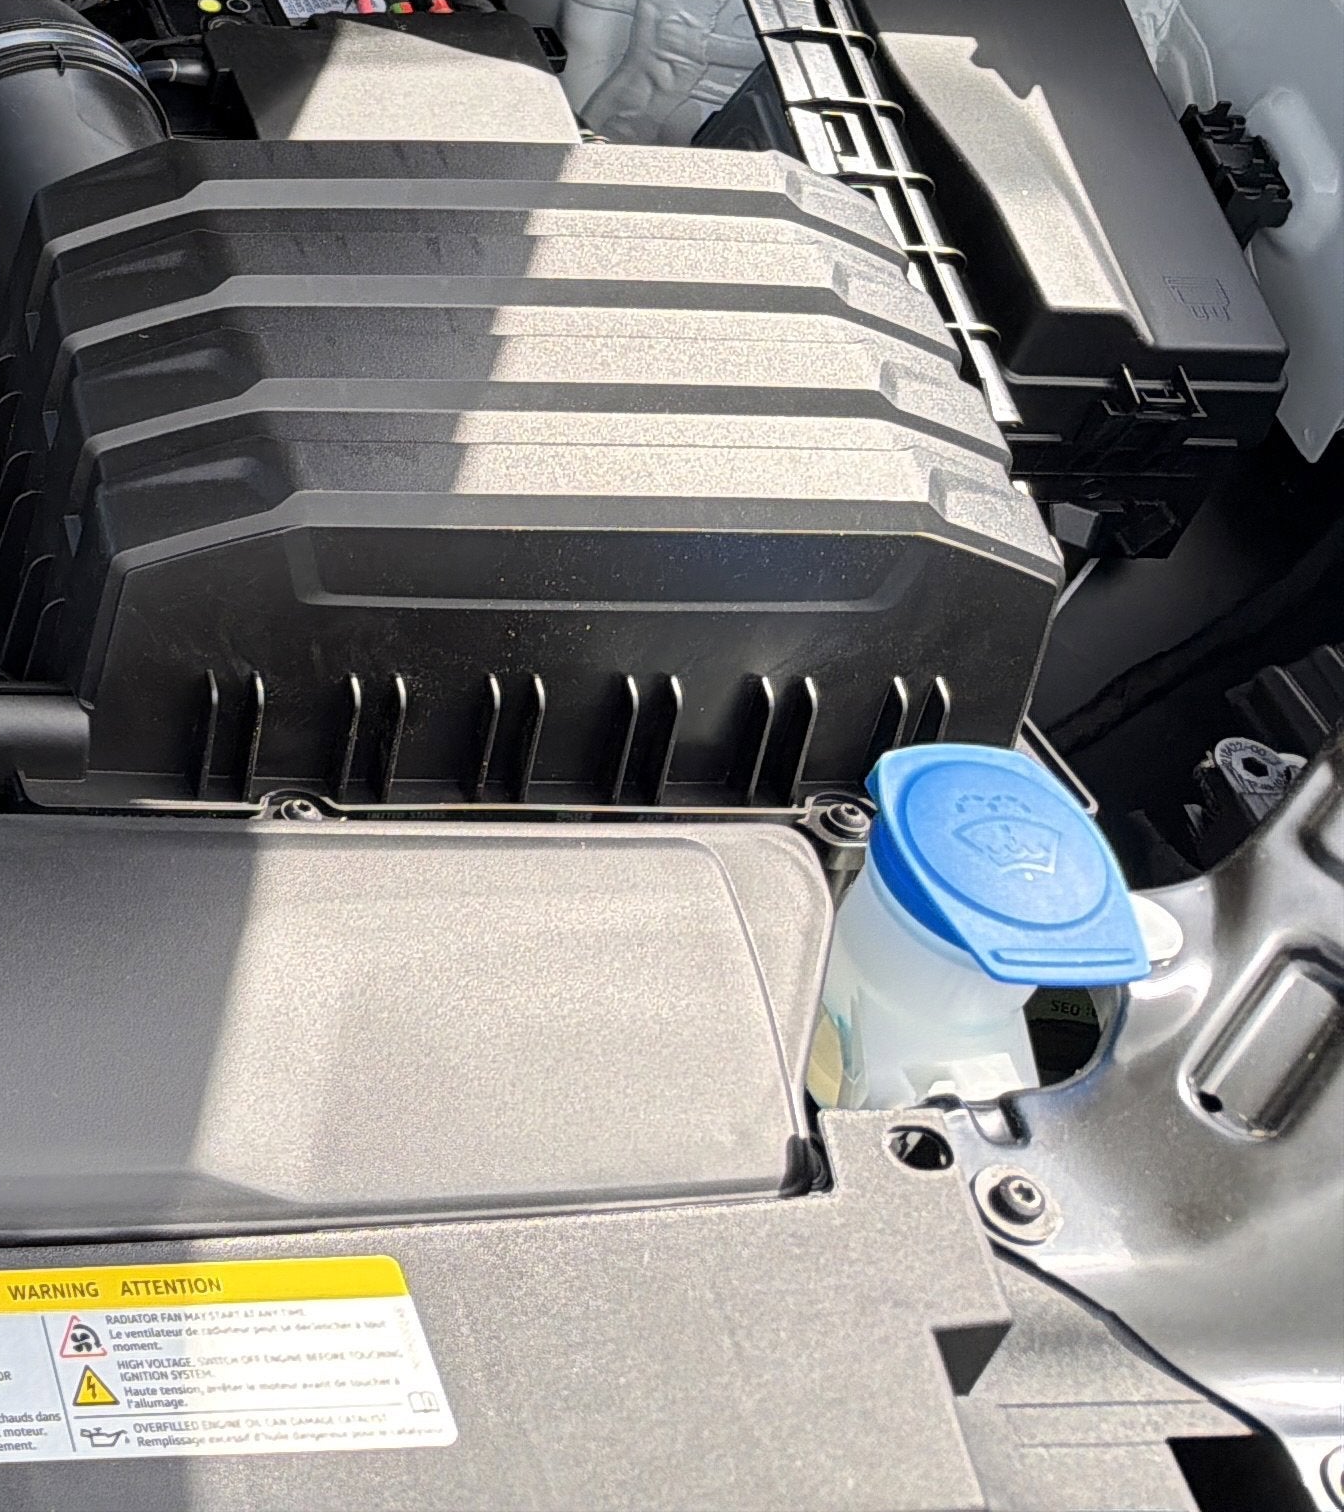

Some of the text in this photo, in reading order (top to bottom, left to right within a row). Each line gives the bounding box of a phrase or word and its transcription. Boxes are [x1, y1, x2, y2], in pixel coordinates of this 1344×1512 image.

[7, 1277, 222, 1301] WARNING ATTENTION
[105, 1314, 159, 1325] RADIATOR
[161, 1312, 182, 1324] FAN
[108, 1329, 123, 1339] Le
[124, 1326, 184, 1338] ventilateur
[185, 1326, 198, 1336] de
[112, 1341, 163, 1352] moment.
[116, 1359, 145, 1370] HIGH
[146, 1357, 196, 1369] VOLTAGE.
[120, 1370, 169, 1382] IGNITION
[123, 1385, 158, 1397] Haute
[35, 1410, 62, 1422] dans
[3, 1426, 47, 1437] moteur.
[132, 1419, 199, 1433] OVERFILLED
